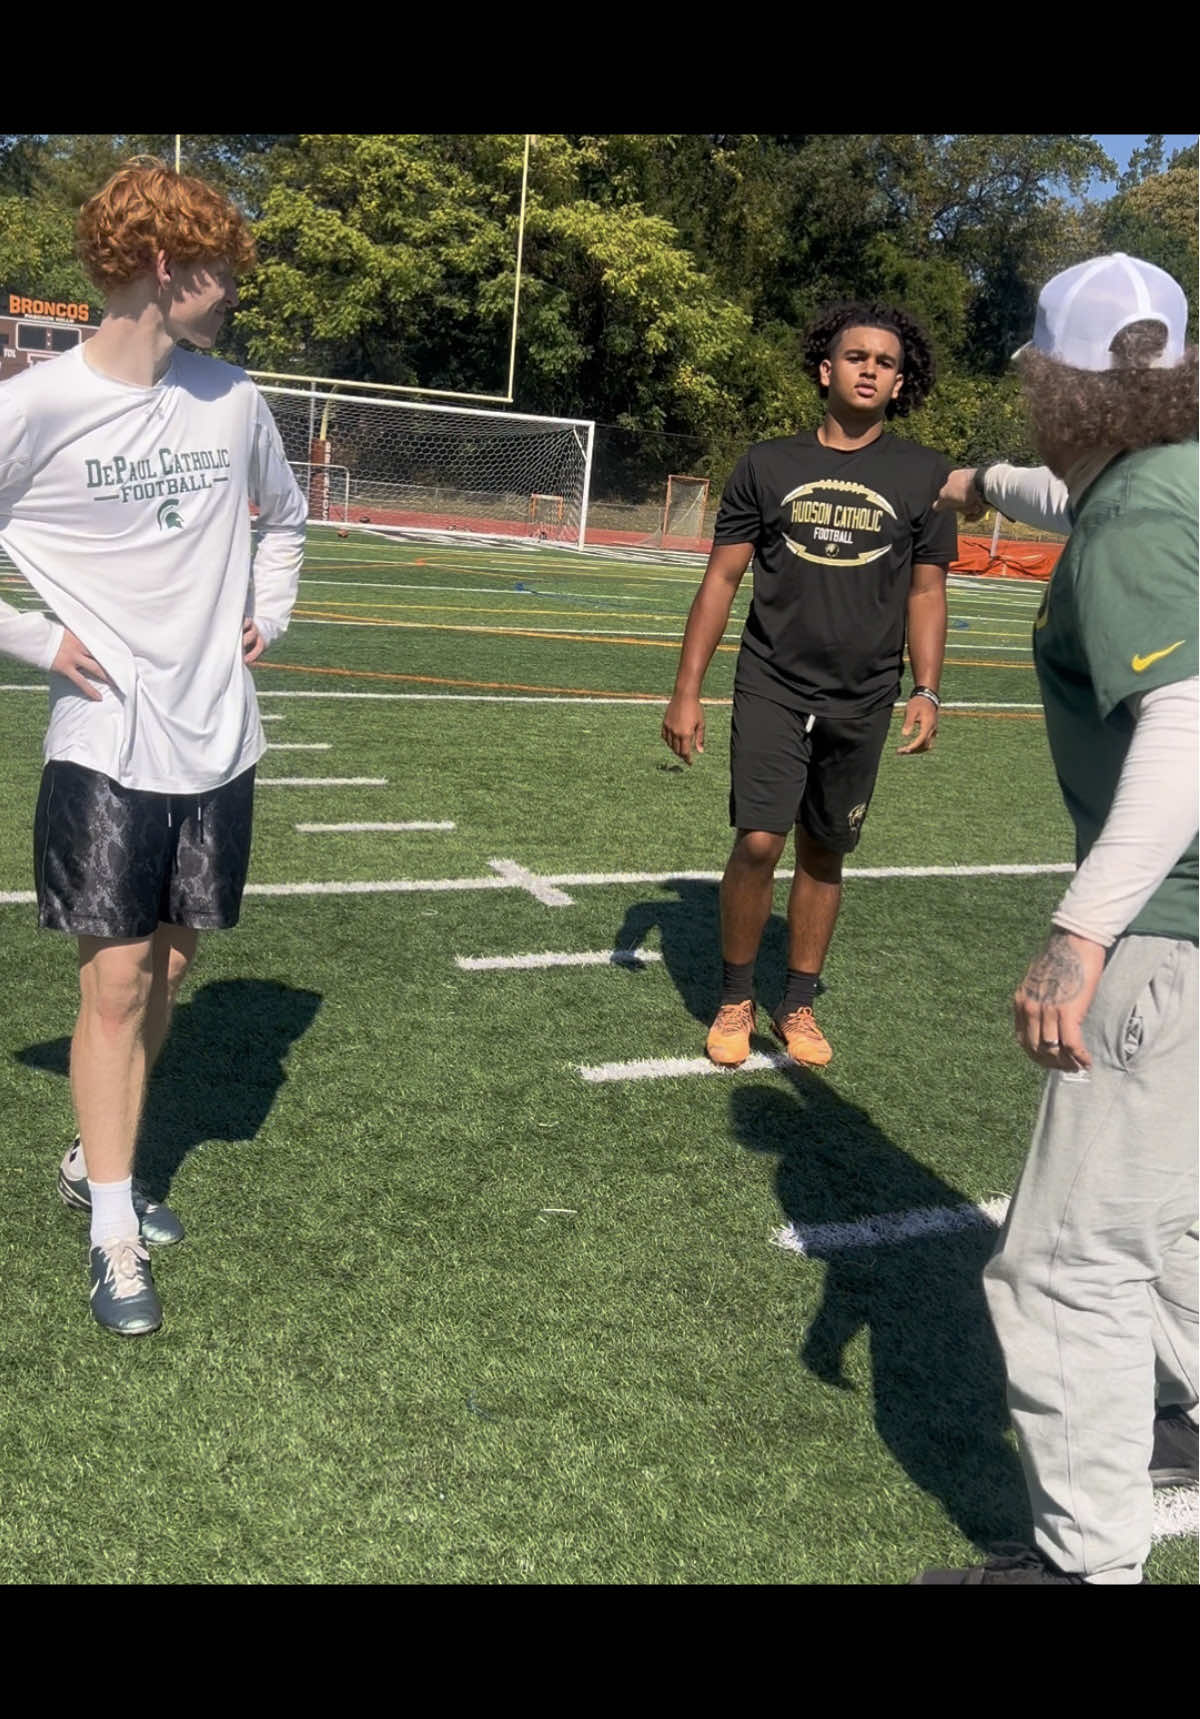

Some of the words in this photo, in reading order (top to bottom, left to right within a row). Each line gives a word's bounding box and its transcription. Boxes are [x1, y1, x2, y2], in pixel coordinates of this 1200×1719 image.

[9, 294, 89, 321] BRONCOS
[158, 447, 231, 476] CATHOLIC
[120, 473, 212, 503] FOOTBALL
[791, 500, 833, 525] HUDSON
[833, 505, 884, 532] CATHOLIC
[813, 526, 854, 544] FOOTBALL
